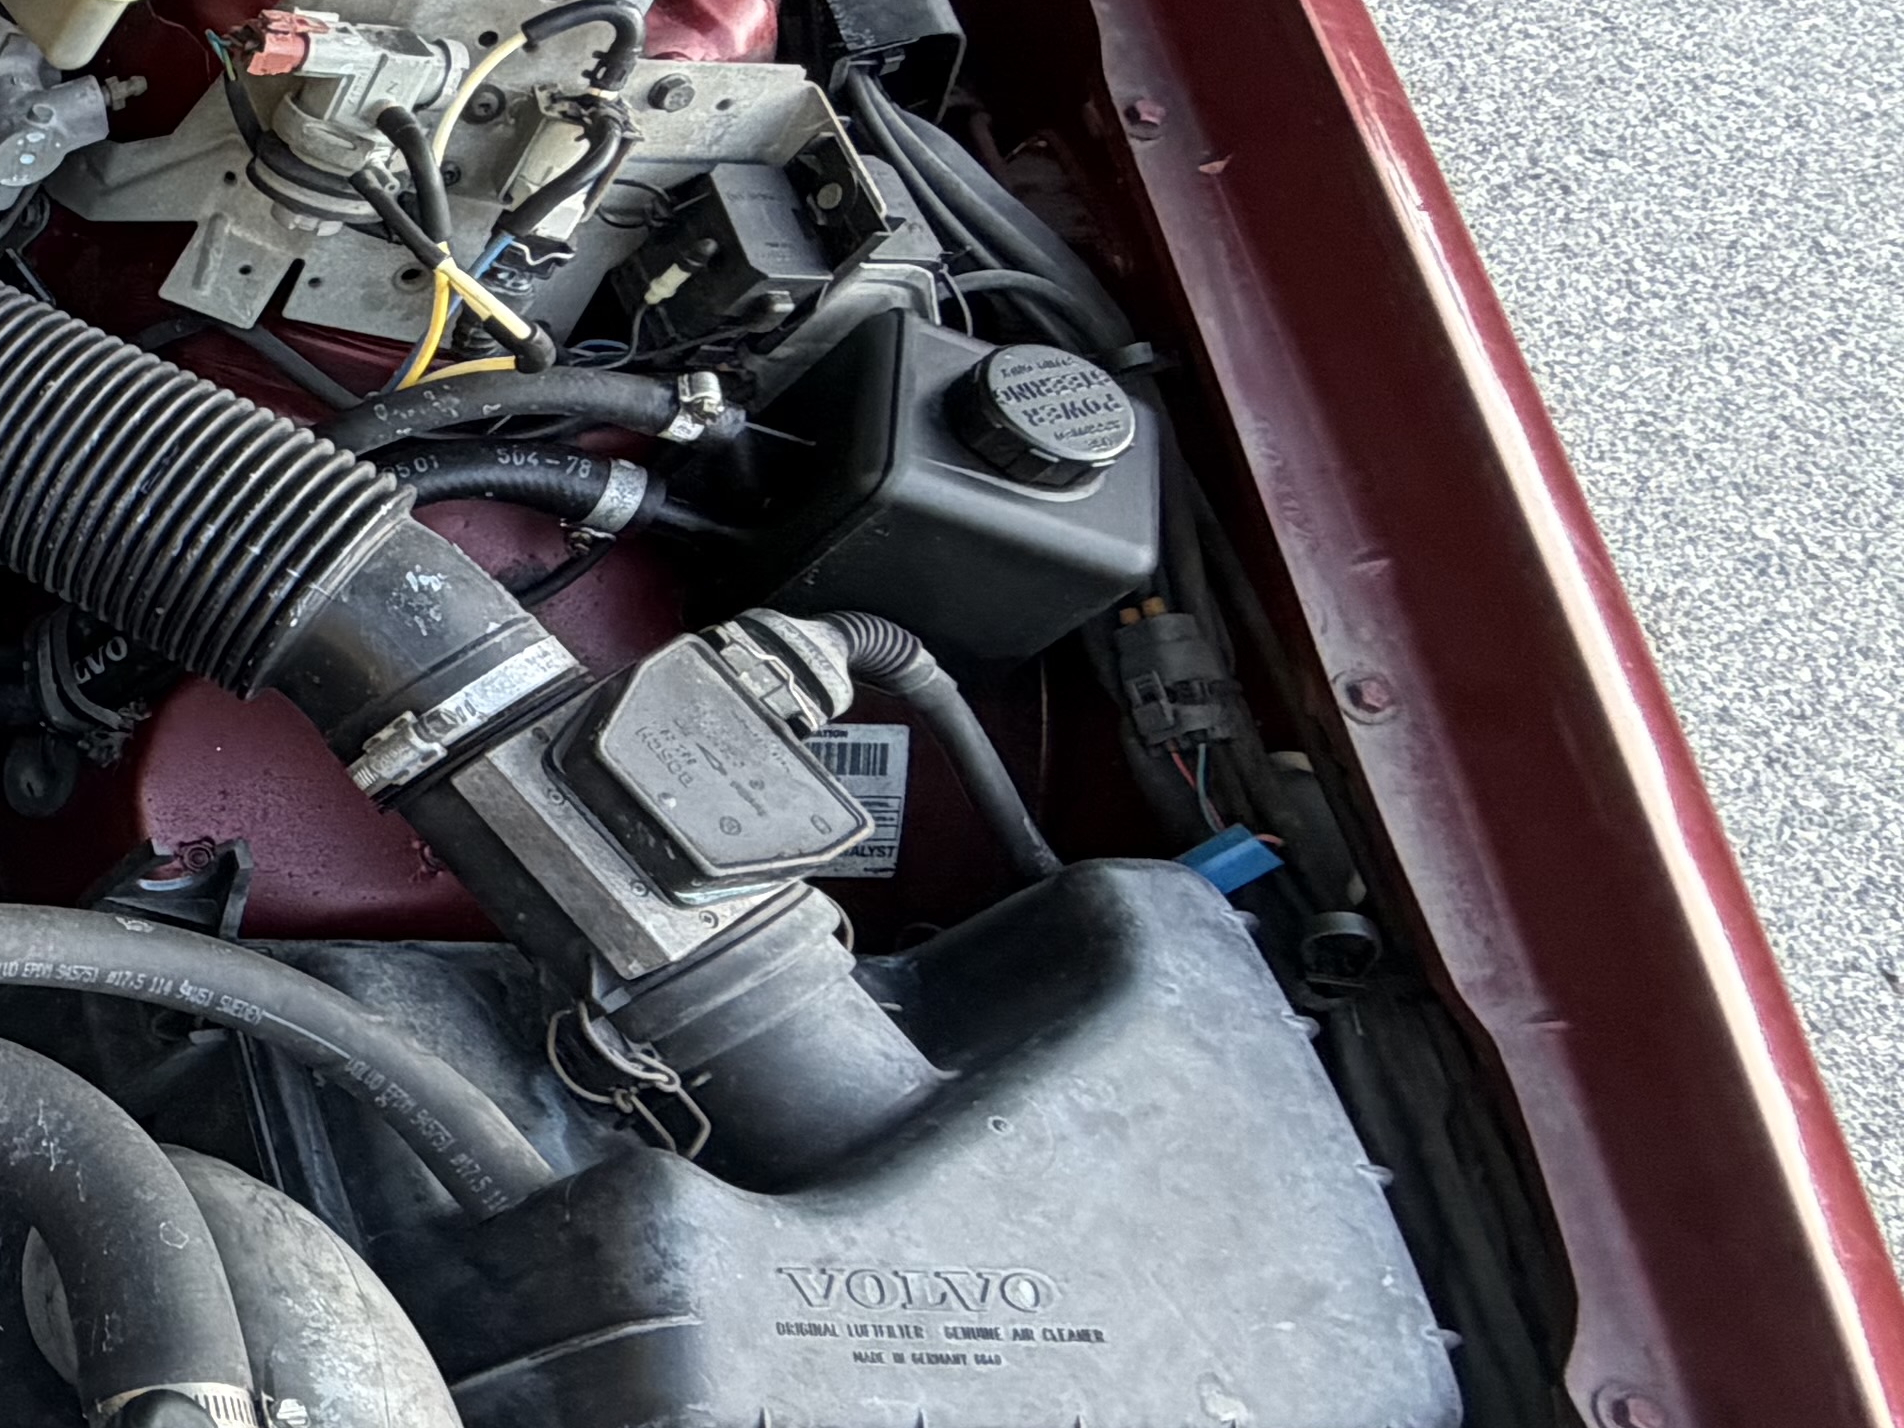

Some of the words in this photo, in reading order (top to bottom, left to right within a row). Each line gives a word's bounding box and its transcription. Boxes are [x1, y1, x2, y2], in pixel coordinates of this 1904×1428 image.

[991, 369, 1110, 405] STEERING
[1020, 393, 1123, 427] POWER
[73, 635, 129, 685] LVO
[21, 962, 53, 978] EPDM
[482, 1189, 510, 1212] 11
[775, 1266, 1061, 1313] VOLVO
[775, 1321, 839, 1337] ORIGINAL
[943, 1325, 1002, 1341] GENUINE
[1012, 1327, 1035, 1341] AIR
[1042, 1328, 1107, 1343] CLEANER
[853, 1351, 884, 1364] MADE
[892, 1352, 905, 1364] IN
[911, 1352, 967, 1365] GERMANY
